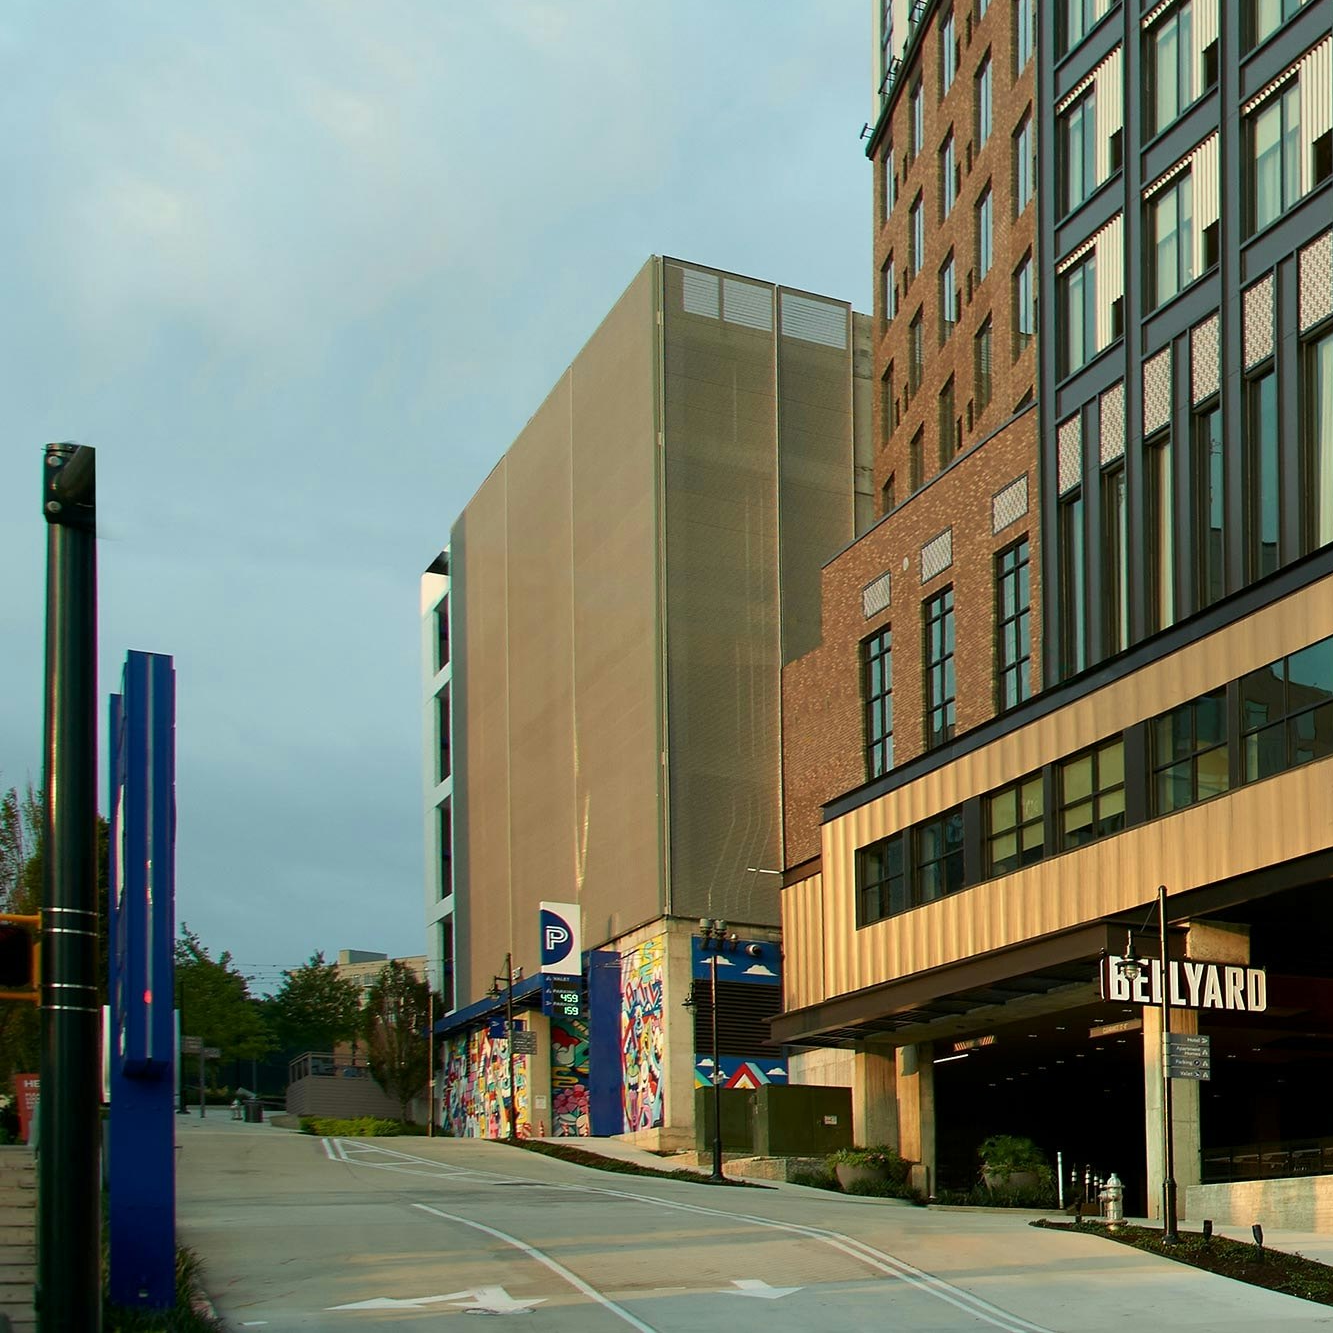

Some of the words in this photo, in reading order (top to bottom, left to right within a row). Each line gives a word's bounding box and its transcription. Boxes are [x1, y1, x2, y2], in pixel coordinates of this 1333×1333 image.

[545, 926, 568, 950] P
[1109, 955, 1267, 1012] BELLYARD
[560, 993, 579, 1003] 459
[564, 1006, 579, 1015] 159
